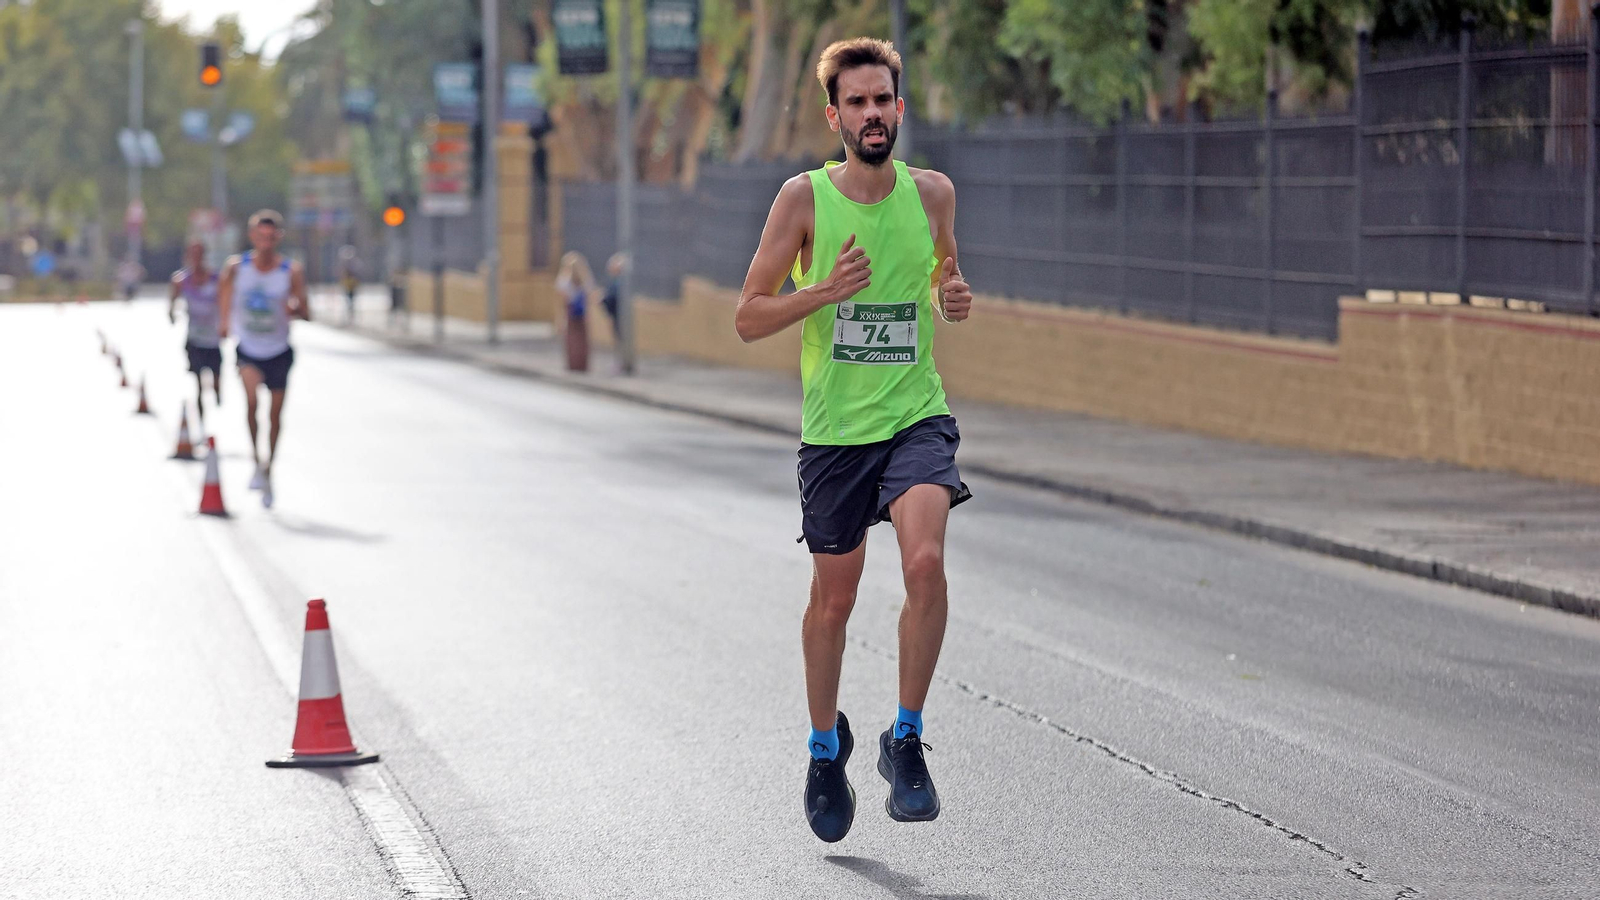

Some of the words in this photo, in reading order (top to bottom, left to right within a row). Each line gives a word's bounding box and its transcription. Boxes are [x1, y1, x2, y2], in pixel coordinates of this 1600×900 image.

[859, 312, 881, 320] XXIX
[862, 324, 890, 344] 74
[864, 351, 910, 361] MIZUNO
